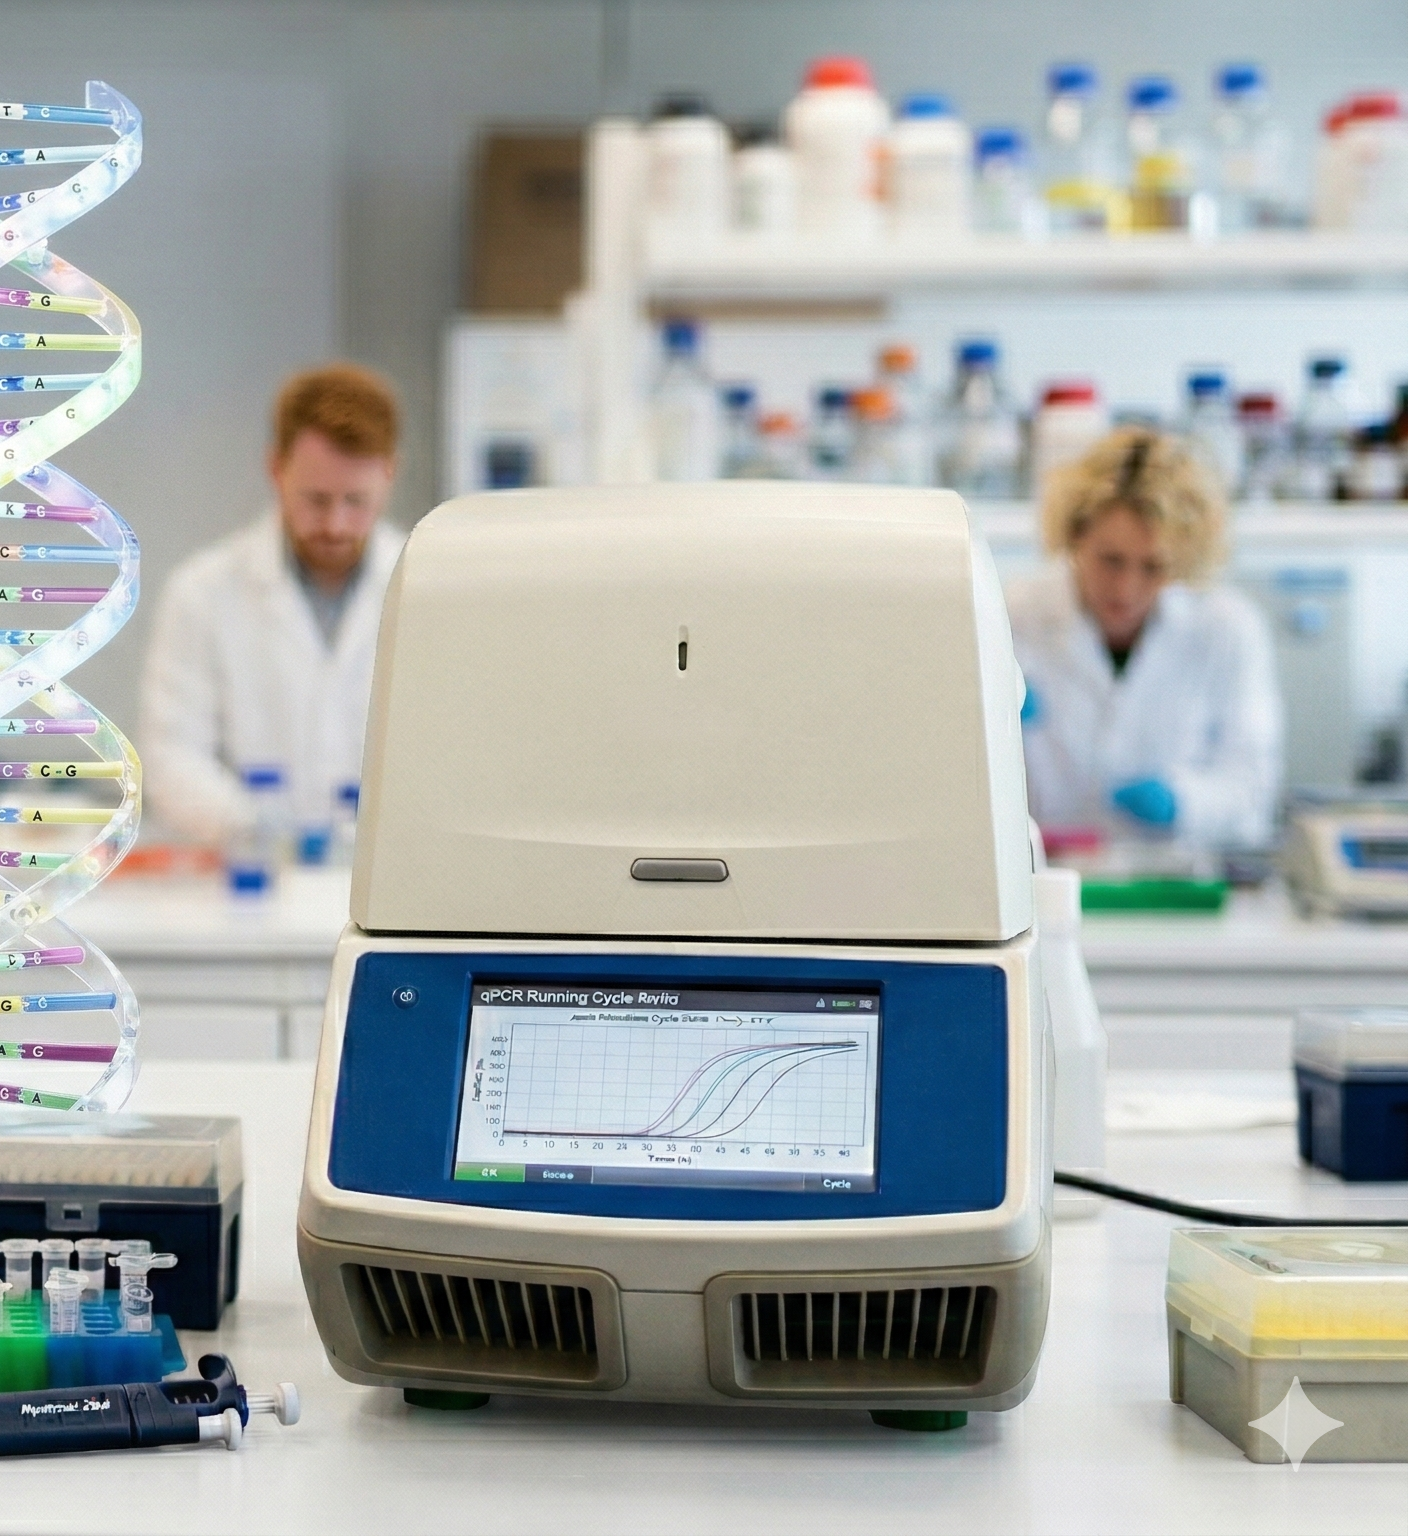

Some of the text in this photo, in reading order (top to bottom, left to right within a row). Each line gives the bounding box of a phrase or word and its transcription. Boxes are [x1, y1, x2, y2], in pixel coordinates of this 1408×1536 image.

[36, 150, 46, 161] A
[4, 231, 14, 241] G
[8, 291, 51, 307] C G
[0, 335, 46, 347] C A
[34, 378, 45, 389] A
[66, 409, 75, 419] G
[4, 449, 15, 460] G
[0, 546, 9, 558] C
[32, 589, 44, 600] G
[7, 721, 16, 732] A
[2, 765, 13, 776] C
[33, 811, 42, 821] A
[29, 855, 37, 866] A
[480, 989, 524, 1004] qPCR
[527, 990, 589, 1006] Running
[592, 991, 634, 1006] Cycle
[33, 1046, 44, 1057] G
[32, 1093, 41, 1104] A
[485, 1117, 500, 1125] 100
[498, 1139, 505, 1147] 0
[544, 1140, 555, 1148] 10
[569, 1141, 579, 1149] 15
[592, 1142, 604, 1150] 20
[641, 1143, 653, 1151] 30
